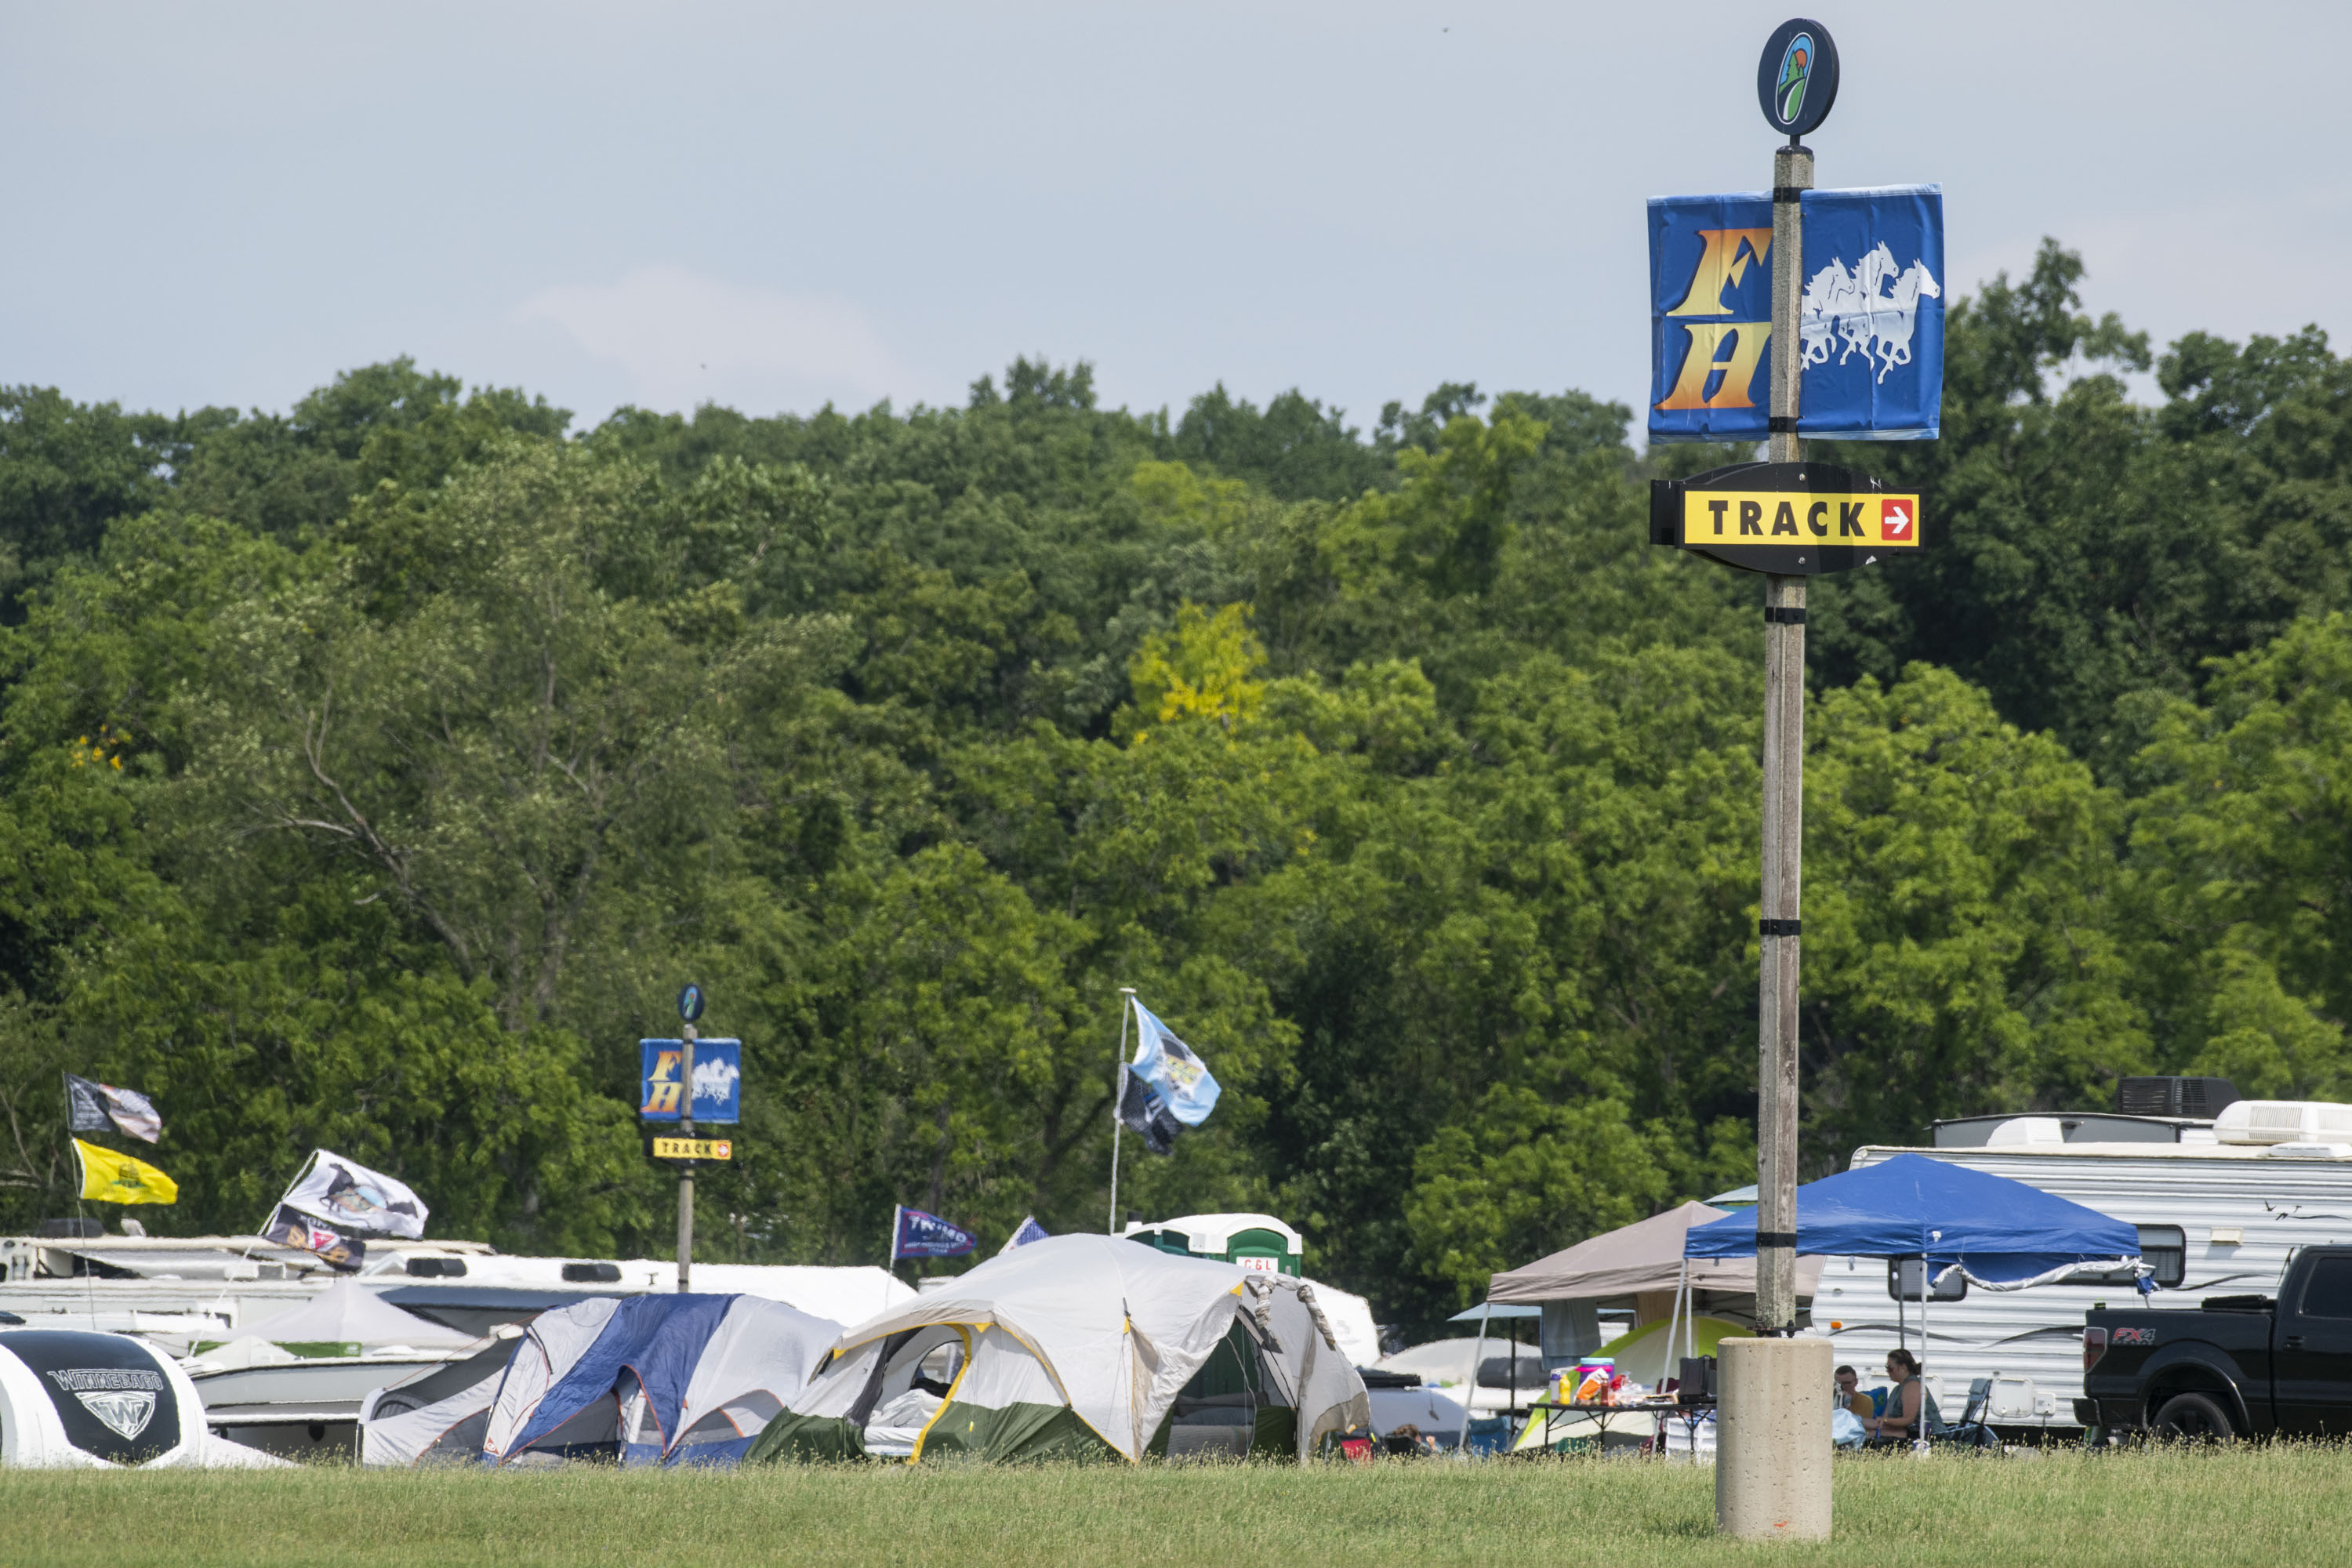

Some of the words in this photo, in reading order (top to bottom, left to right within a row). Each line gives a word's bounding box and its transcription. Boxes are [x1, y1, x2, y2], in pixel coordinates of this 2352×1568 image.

[1665, 227, 1773, 316] F
[1653, 321, 1772, 409] H
[1708, 500, 1866, 537] TRACK
[648, 1051, 683, 1081] F
[640, 1081, 684, 1112] H
[662, 1141, 712, 1154] TRACK
[1255, 1259, 1262, 1270] &
[1266, 1260, 1271, 1270] L
[2113, 1327, 2156, 1341] FX4
[47, 1369, 163, 1391] WINNEBAGO
